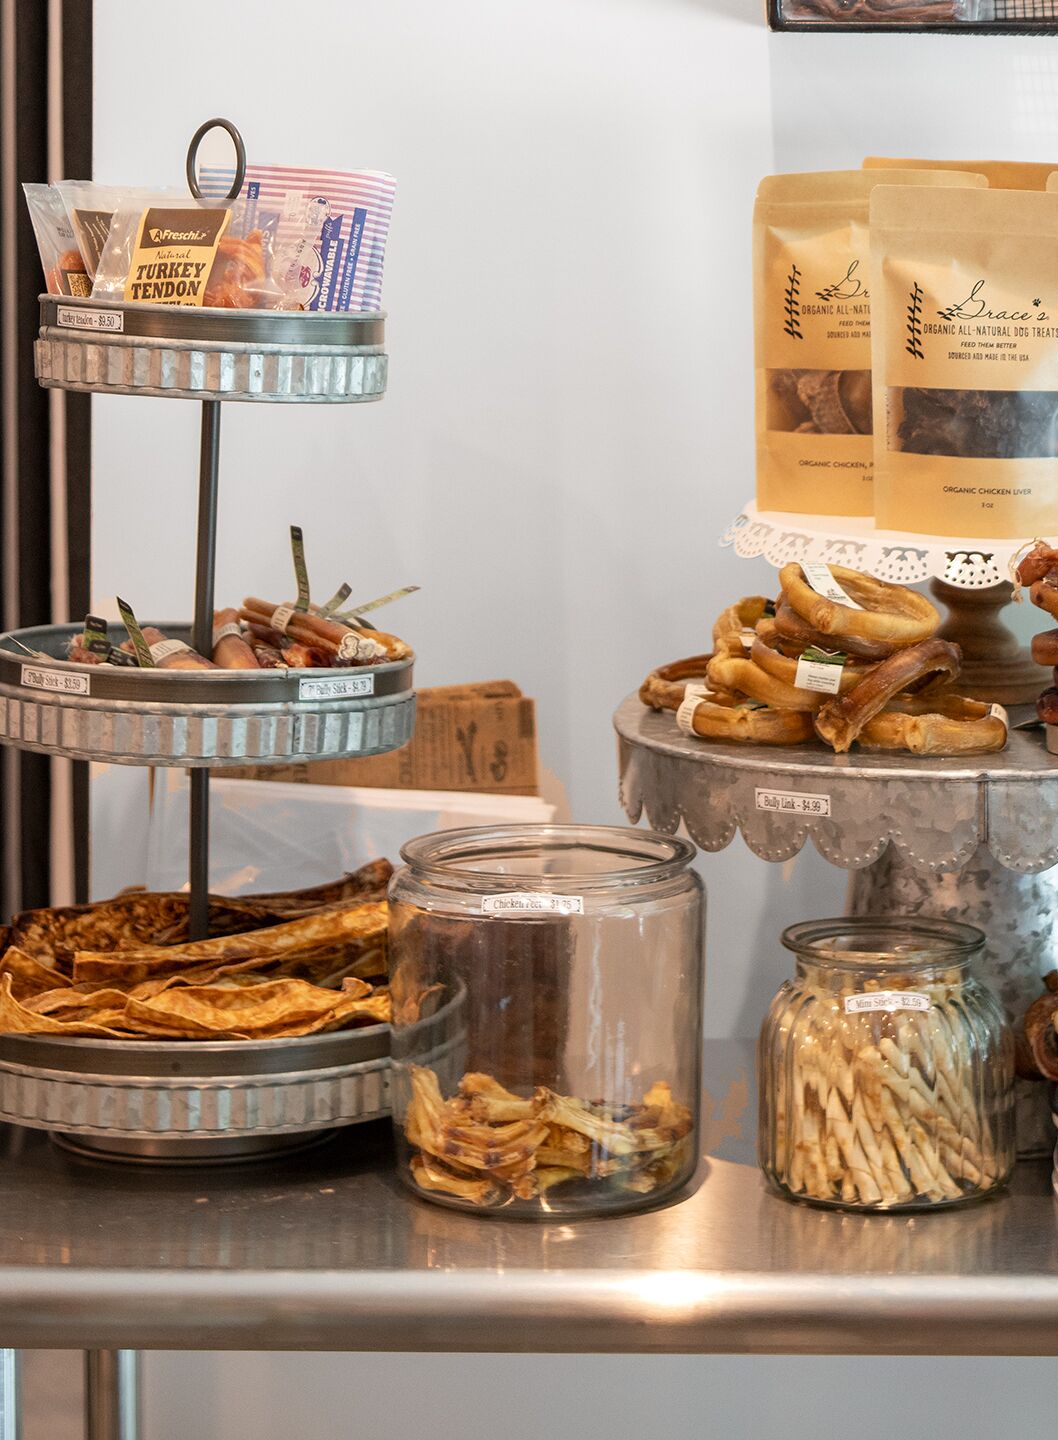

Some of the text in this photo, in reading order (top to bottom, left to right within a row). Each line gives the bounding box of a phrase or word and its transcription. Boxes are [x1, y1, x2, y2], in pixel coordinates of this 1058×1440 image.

[350, 238, 358, 256] GRAIN
[155, 249, 191, 260] Natural
[136, 262, 206, 280] TURKEY
[131, 280, 201, 300] TENDON
[342, 276, 351, 299] GLUTEN
[941, 280, 1049, 321] Grace's
[802, 304, 833, 315] ORGANIC
[98, 315, 115, 327] $9.50
[923, 323, 956, 335] ORGANIC
[958, 324, 1010, 337] ALL-NATURAL
[1014, 326, 1029, 337] DOG
[948, 352, 971, 360] SOURCED
[1008, 353, 1017, 361] THE
[1019, 353, 1029, 361] USA
[799, 460, 868, 469] ORGANIC CHICKEN,
[943, 486, 976, 495] ORGANIC
[978, 487, 1011, 496] CHICKEN
[764, 795, 820, 812] Bully Link $4.99
[493, 899, 524, 909] Chicken
[856, 1000, 871, 1008] Mini
